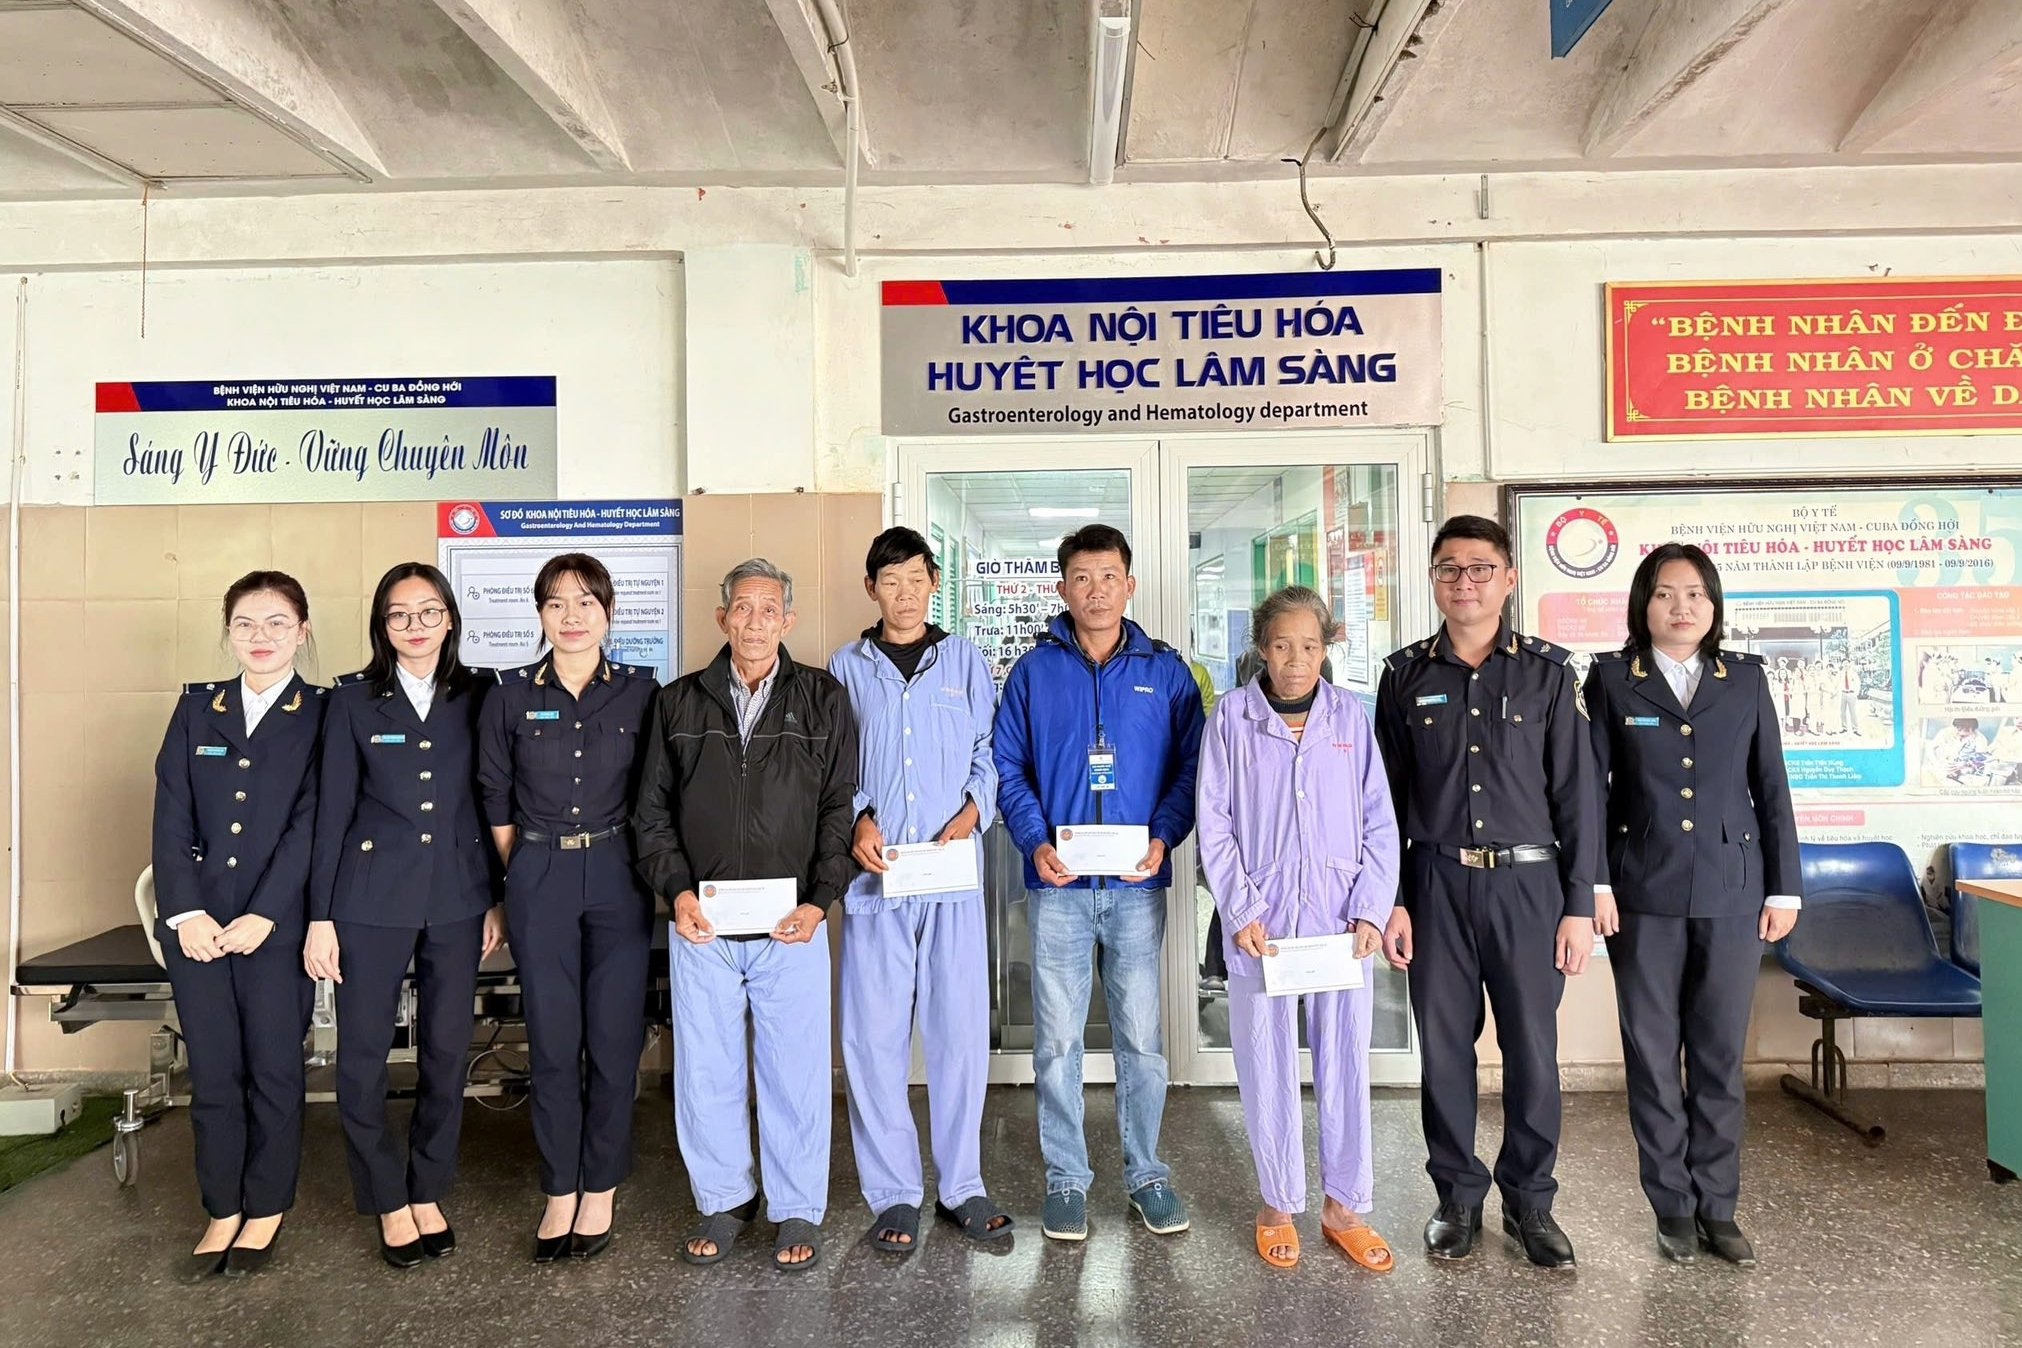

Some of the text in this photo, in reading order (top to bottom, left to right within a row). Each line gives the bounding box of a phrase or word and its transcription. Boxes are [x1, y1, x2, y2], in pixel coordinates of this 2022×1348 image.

[961, 300, 1364, 346] KHOA NỘI TIÊU HÓA
[1788, 308, 1897, 336] NHÂN
[1909, 302, 1991, 333] ĐẾN
[1666, 348, 1774, 378] BỆNH
[1786, 346, 1895, 373] NHÂN
[1908, 342, 1934, 370] Ở
[1078, 358, 1160, 394] HỌC
[1176, 352, 1266, 387] LÂM
[1278, 348, 1397, 385] SÀNG
[213, 380, 462, 396] BỆNH VIỆN HỮU NGHỊ VIỆT NAM CU BA ĐỒNG HỚI
[1685, 374, 1978, 414] BỆNH NHÂN VỀ
[227, 394, 446, 408] KHOA NỘI TIÊU HÓA HUYẾT HỌC LÂM SÀNG
[948, 400, 1368, 427] Gastroenterology and Hematology department
[123, 426, 529, 486] Sáng Y Đức Vững Chuyên Môn
[525, 509, 547, 519] KHOA
[547, 508, 561, 521] NỘI
[562, 508, 578, 519] TIÊU
[579, 507, 596, 518] HÓA
[601, 506, 625, 518] HUYẾT
[625, 508, 642, 520] HỌC
[643, 507, 659, 518] LÂM
[660, 506, 680, 518] SÀNG
[1792, 504, 1837, 520] BỘ Y TẾ
[521, 522, 573, 530] Gastroenterology
[587, 521, 623, 529] Hematology
[624, 521, 660, 529] Department
[1671, 523, 1703, 537] BỆNH
[1706, 522, 1735, 536] VIỆN
[1738, 522, 1764, 533] HỮU
[1767, 524, 1797, 535] NGHỊ
[1800, 520, 1828, 534] VIỆT
[1830, 523, 1856, 532] NAM
[1866, 522, 1898, 531] CUBA
[1901, 518, 1935, 531] ĐỒNG
[1723, 539, 1761, 554] TIÊU
[1766, 538, 1800, 554] HÓA
[1813, 534, 1868, 552] HUYẾT
[1872, 540, 1905, 555] HỌC
[1910, 536, 1943, 551] LÂM
[1947, 535, 1992, 551] SÀNG
[976, 558, 1047, 574] GIỜ THĂM
[1725, 557, 1994, 572] NĂM THÀNH LẬP BỆNH VIỆN (09/9/1981 09/9/2016)
[997, 582, 1019, 594] THỨ
[1021, 585, 1027, 594] 2
[974, 603, 1006, 616] Sáng:
[975, 625, 1004, 636] Trưa:
[999, 646, 1012, 657] 16
[1133, 685, 1154, 694] WIPRO
